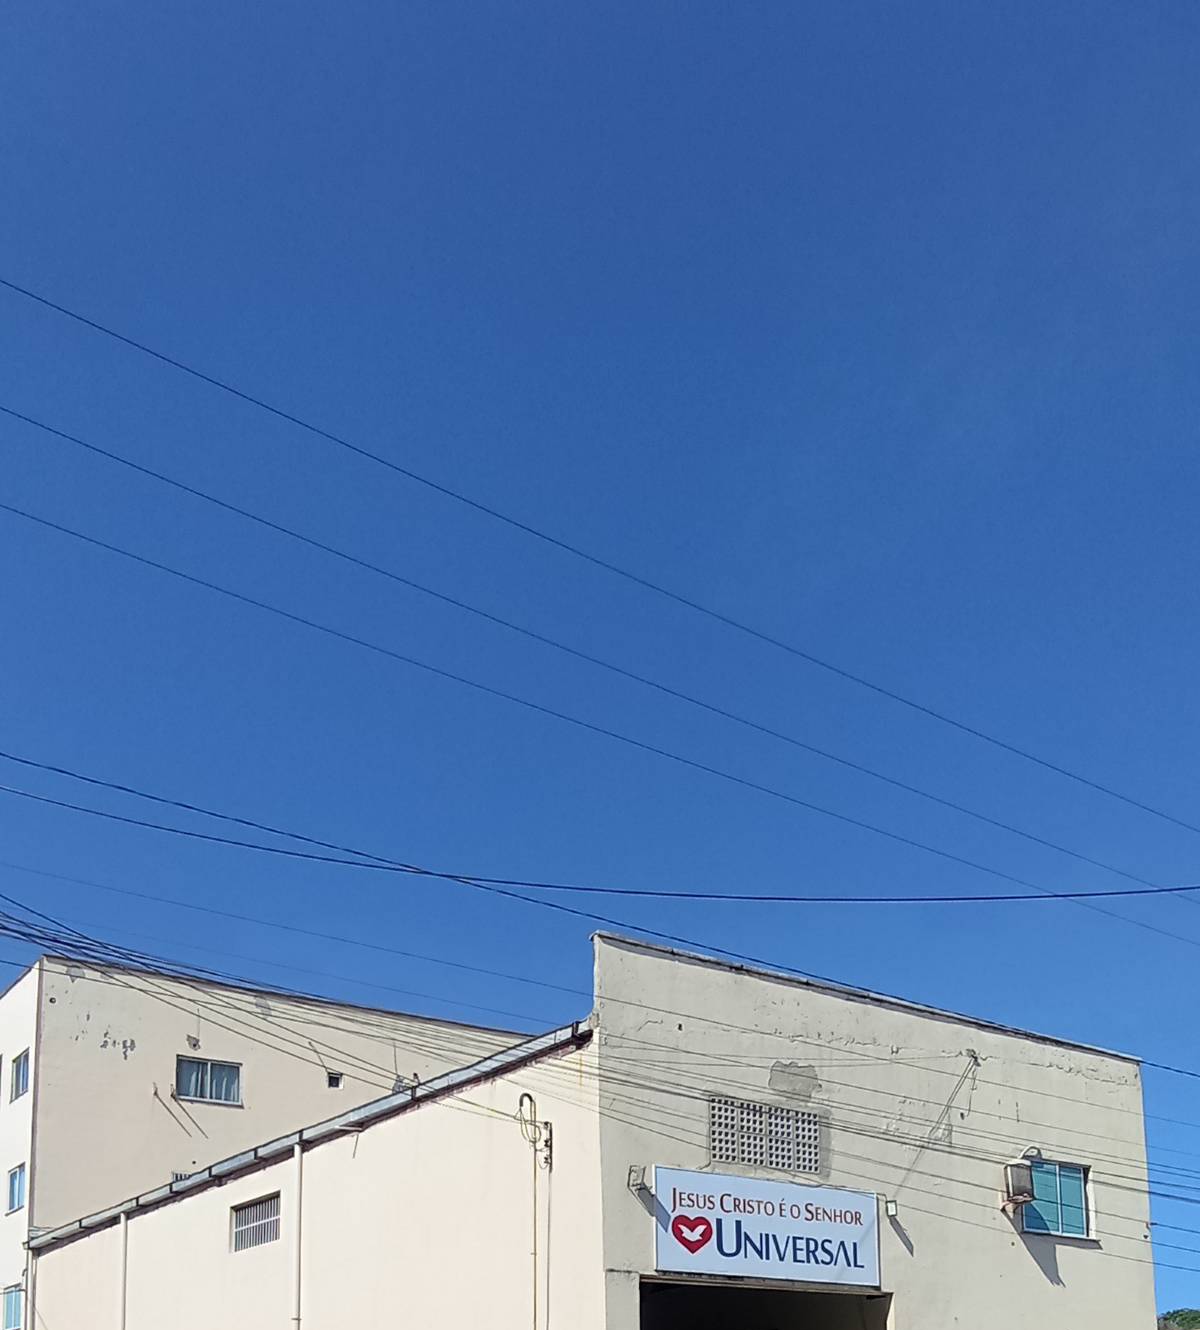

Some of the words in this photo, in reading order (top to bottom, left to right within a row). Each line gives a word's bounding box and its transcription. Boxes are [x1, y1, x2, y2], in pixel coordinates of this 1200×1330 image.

[671, 1187, 715, 1213] JESUS
[720, 1193, 775, 1217] CRISTO
[779, 1198, 787, 1217] É
[790, 1204, 801, 1219] O
[804, 1202, 864, 1226] SENHOR
[716, 1218, 864, 1269] UNIVERSAL
